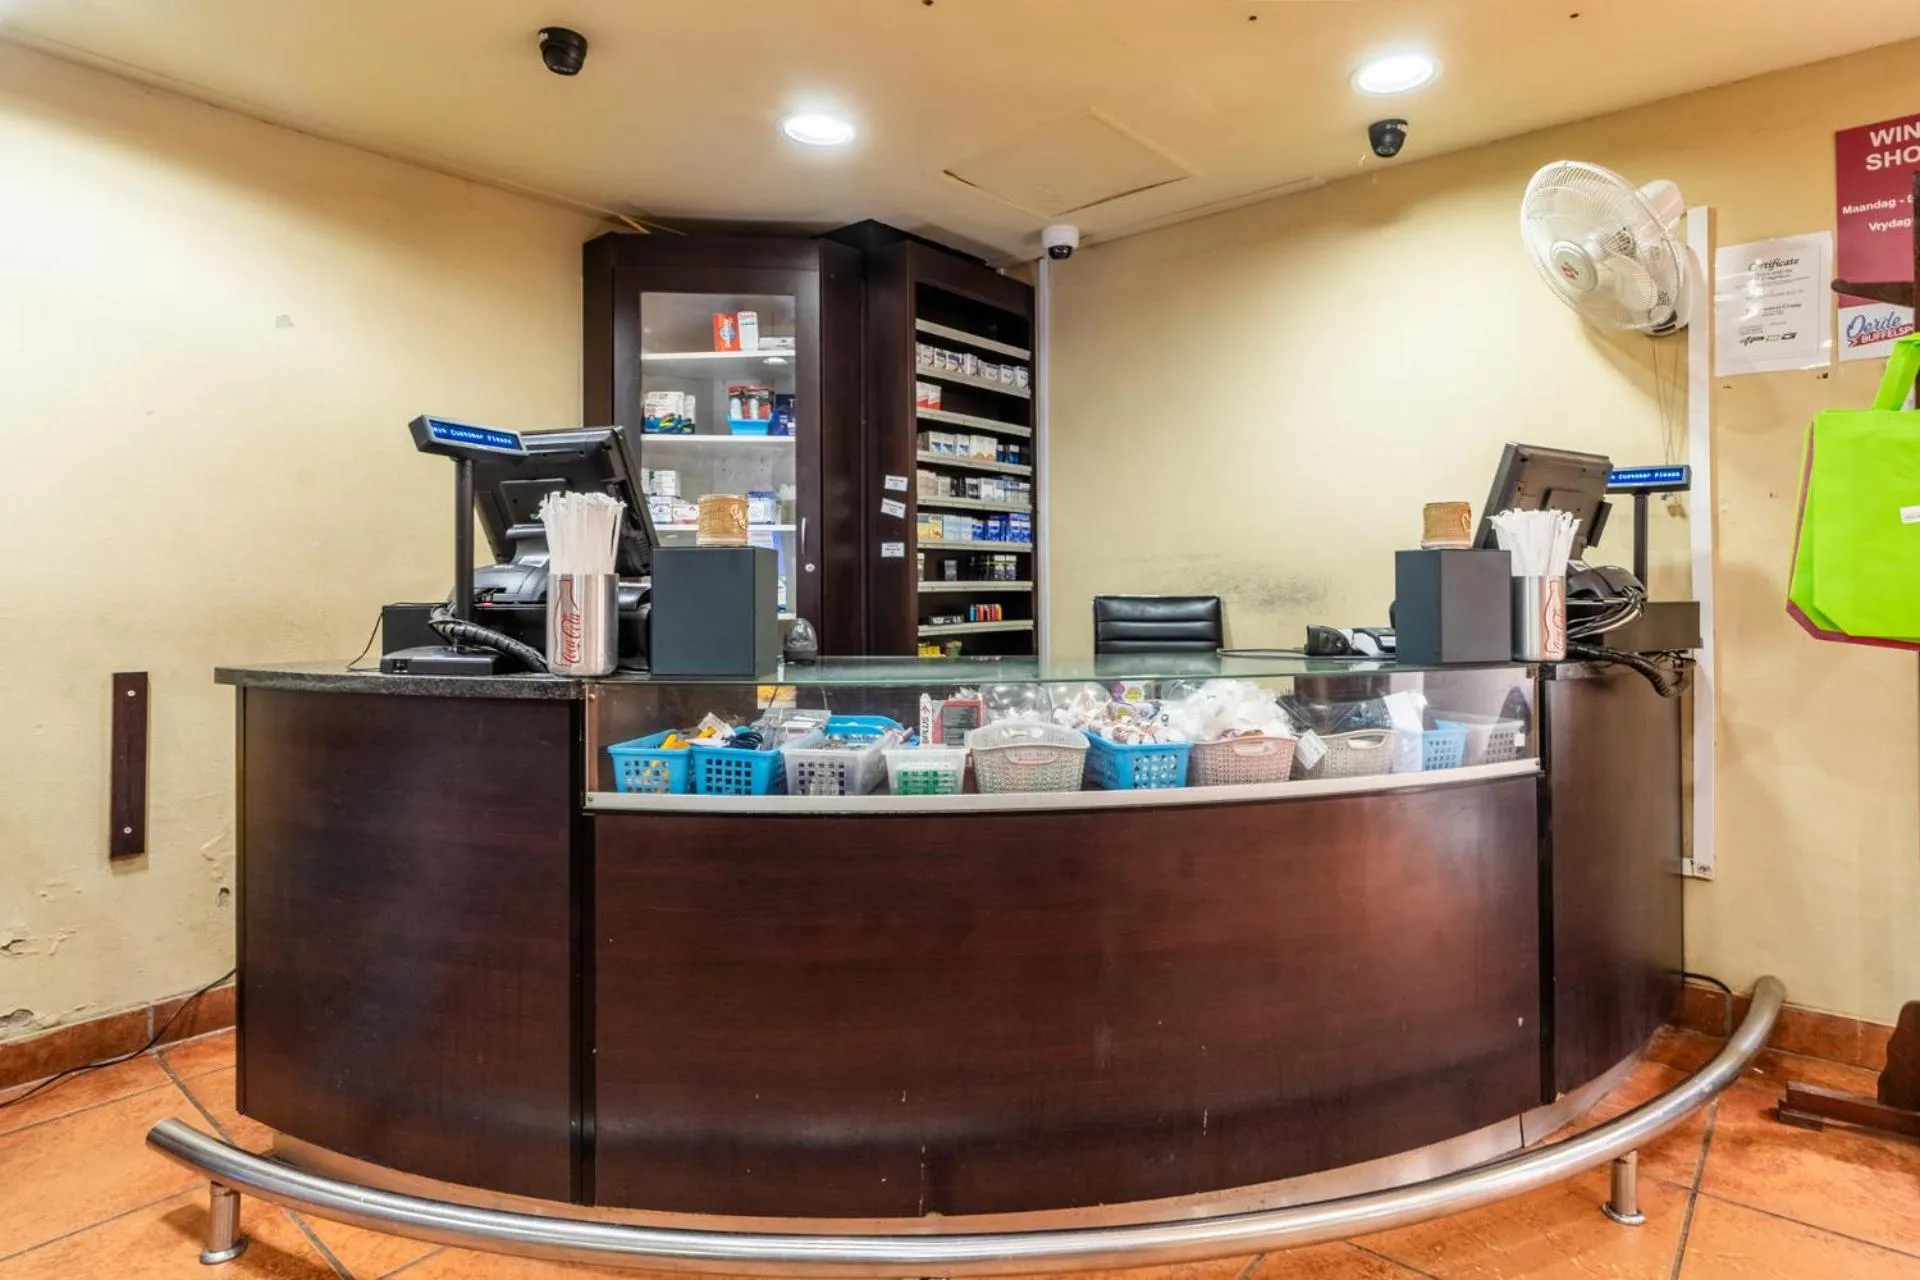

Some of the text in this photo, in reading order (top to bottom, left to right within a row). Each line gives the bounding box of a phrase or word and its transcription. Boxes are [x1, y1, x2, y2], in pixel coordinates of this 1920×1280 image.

[1865, 145, 1920, 171] SHO
[1842, 199, 1897, 215] Maandag
[1868, 217, 1911, 232] Vrydag
[1748, 257, 1800, 272] Crtificate
[487, 435, 512, 445] Please
